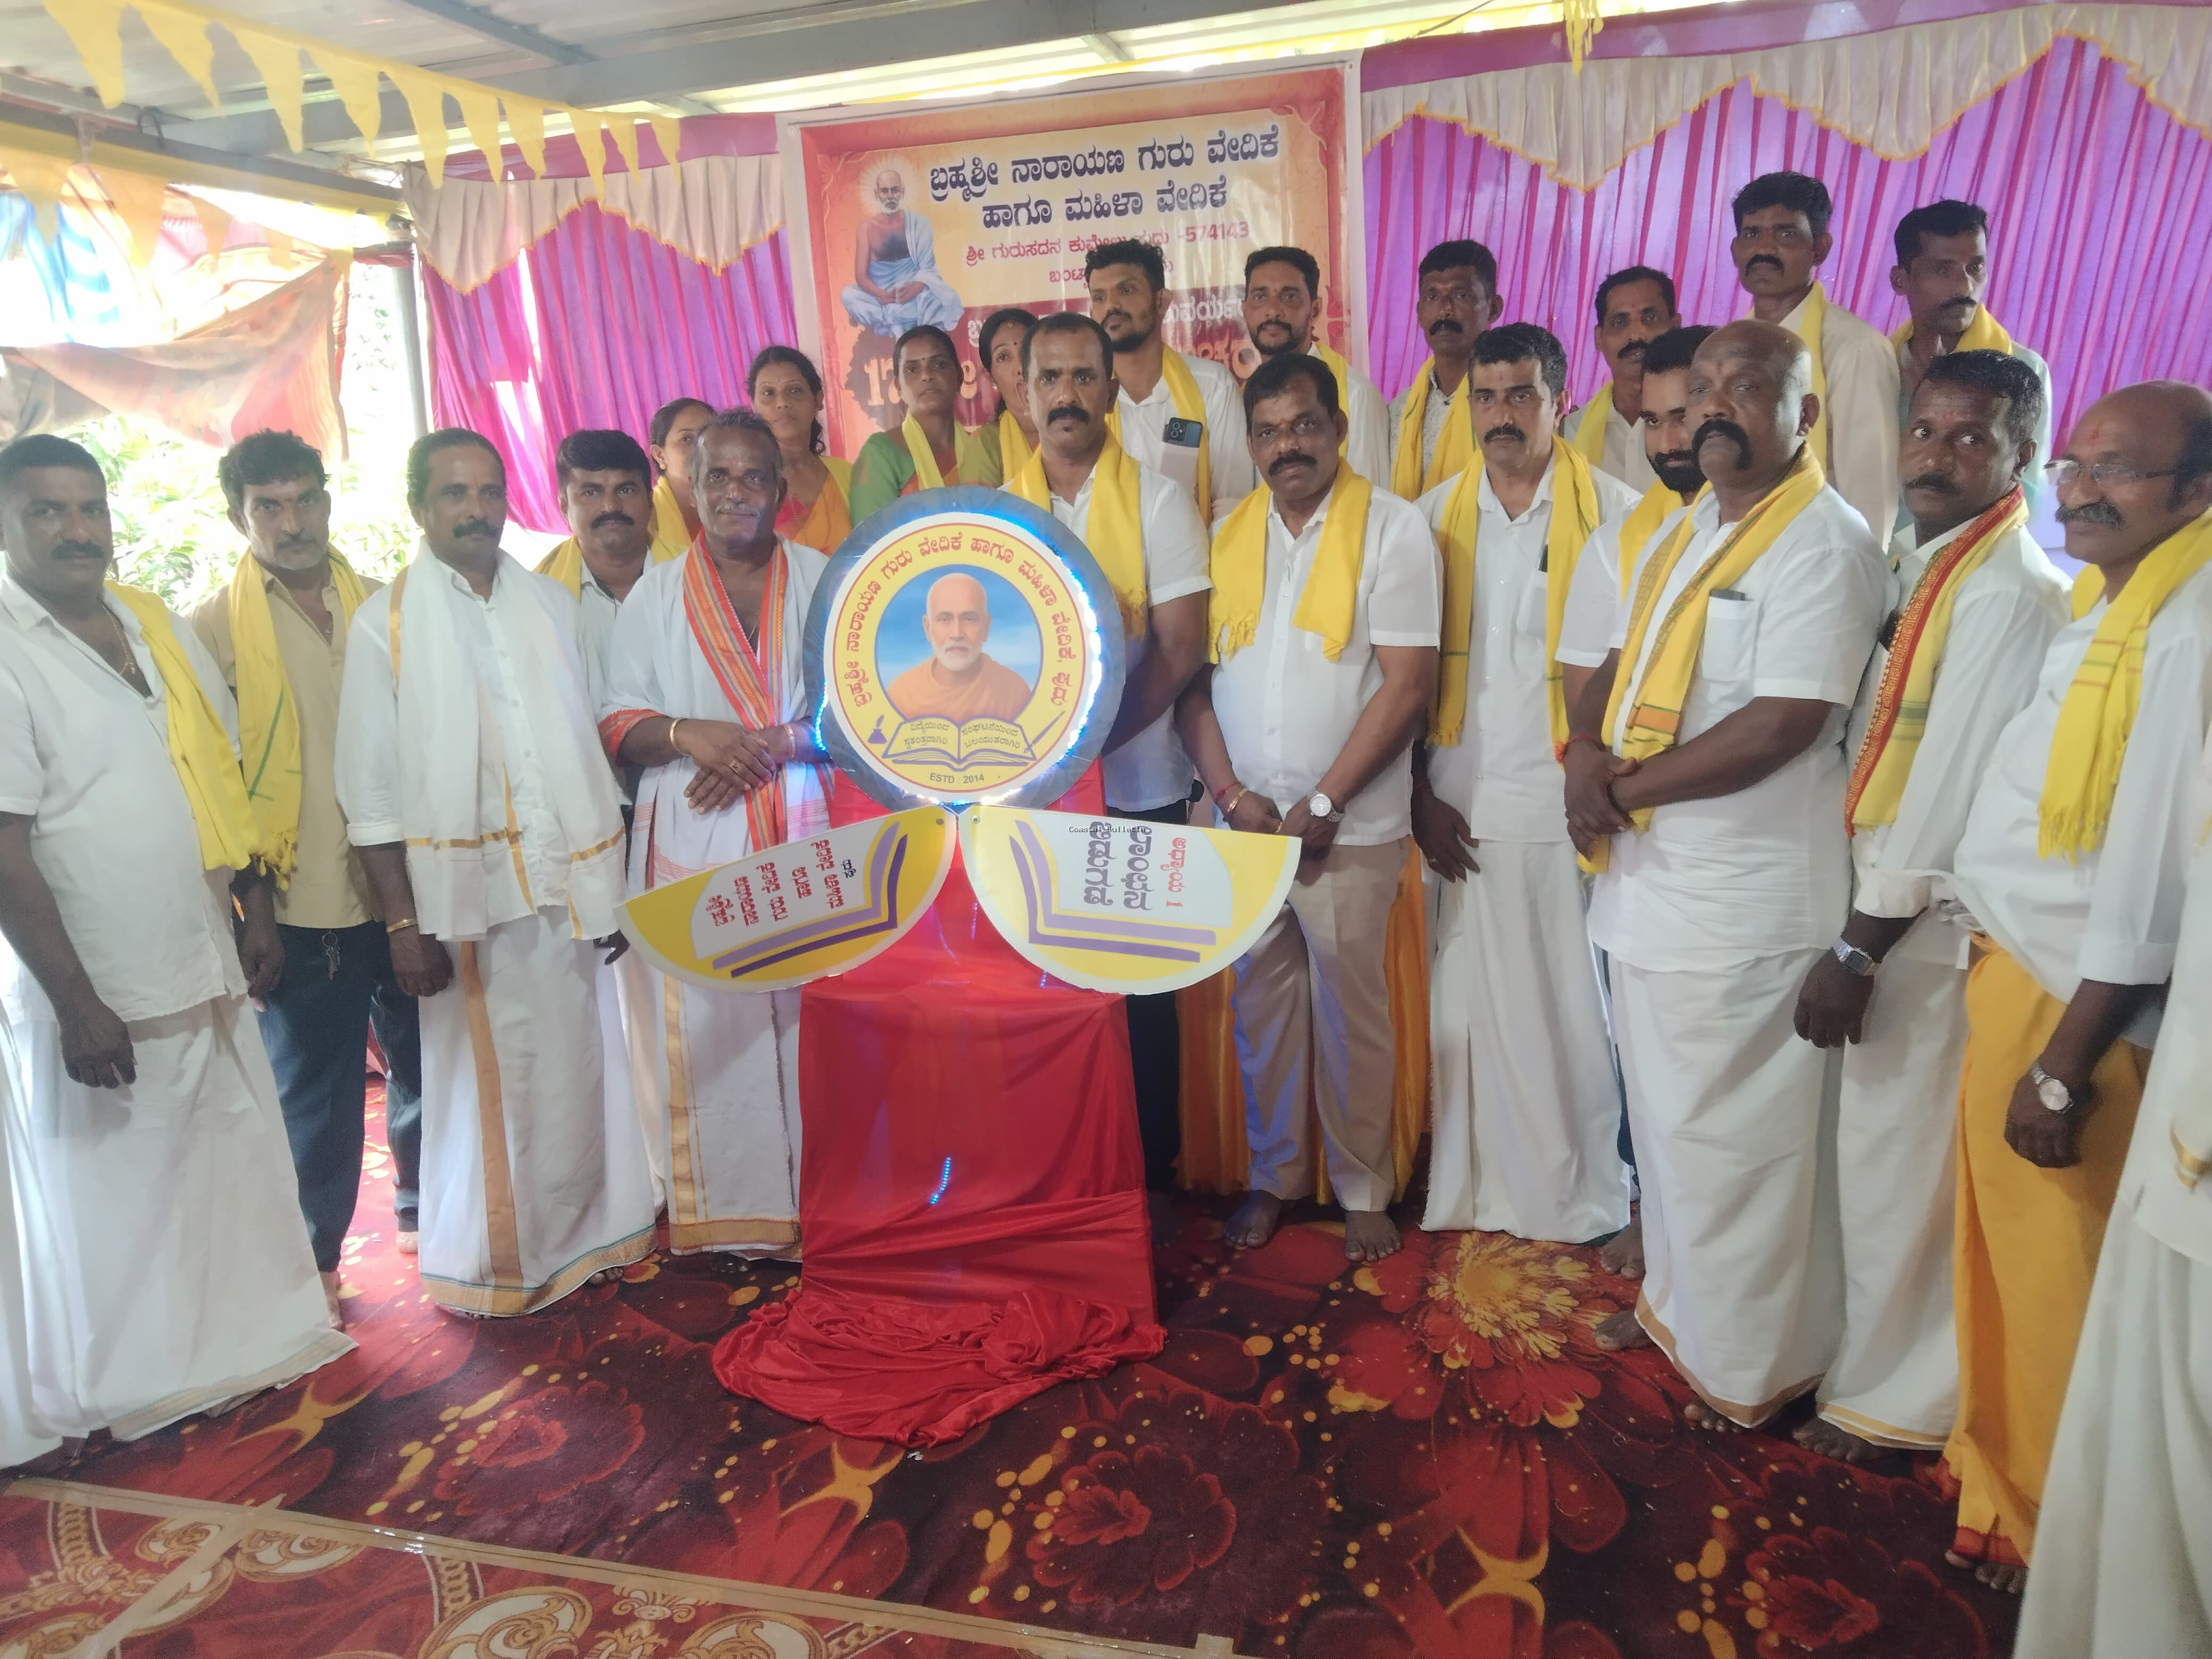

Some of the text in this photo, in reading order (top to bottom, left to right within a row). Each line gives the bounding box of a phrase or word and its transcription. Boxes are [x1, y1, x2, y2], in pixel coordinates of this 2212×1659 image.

[931, 124, 1279, 202] ಬ್ರಹ್ಮಶ್ರೀ ನಾರಾಯಣ ಗುರು ವೇದಿಕೆ
[982, 174, 1227, 229] ಹಾಗೂ ಮಹಿಳಾ ವೇದಿಕೆ
[966, 245, 985, 266] ಶ್ರೀ
[992, 238, 1061, 259] ಗುರುಸದನ
[881, 549, 912, 580] ಗುರು
[918, 531, 963, 557] ವೇದಿಕೆ
[970, 533, 1015, 564] ಹಾಗೂ
[1018, 559, 1057, 607] ಮಹಿಳಾ
[846, 580, 882, 652] ನಾರಾಯಣ
[844, 659, 872, 707] ಬ್ರಹ್ಮಶ್ರೀ
[1051, 671, 1075, 706] ಪುದು
[930, 773, 954, 784] ESTD
[963, 774, 984, 784] 2014
[789, 867, 812, 899] ಹಾಗೂ
[811, 839, 844, 909] ಮಹಿಳಾ ವೇದಿಕೆ
[840, 859, 857, 878] ಪುದು
[1083, 821, 1117, 906] ಬಿಡುಗಡೆ
[1160, 837, 1187, 893] ಅಧ್ಯಾಯ
[734, 876, 759, 926] ನಾರಾಯಣ
[756, 861, 789, 921] ಗುರು ವೇದಿಕೆ
